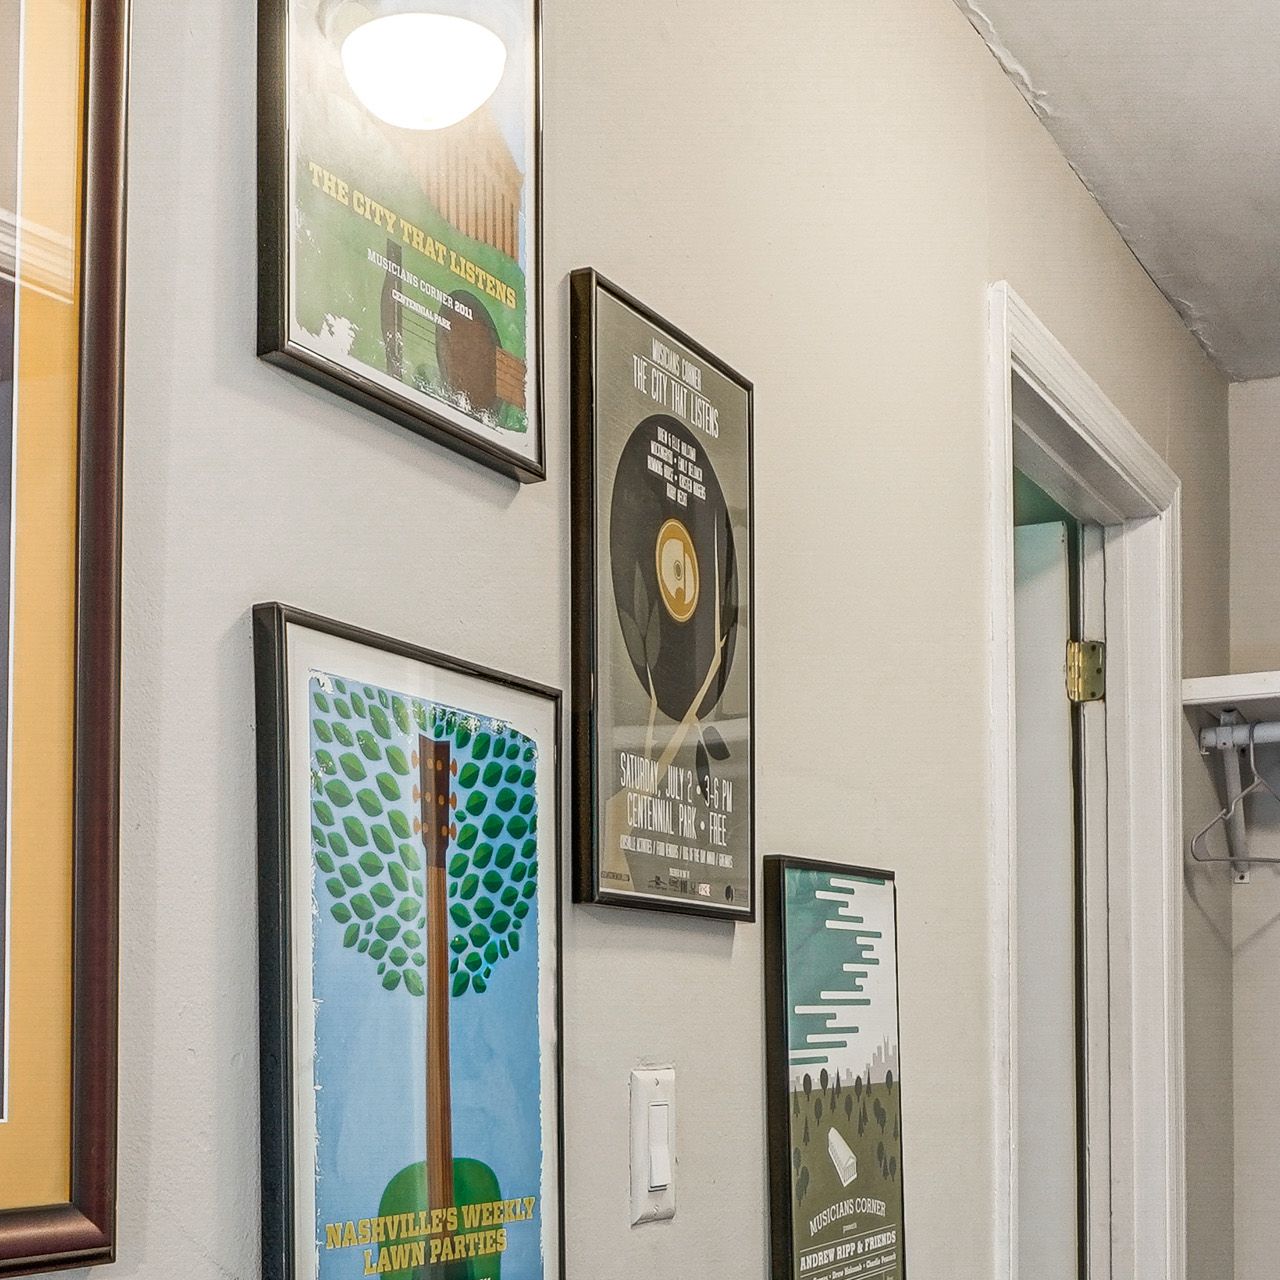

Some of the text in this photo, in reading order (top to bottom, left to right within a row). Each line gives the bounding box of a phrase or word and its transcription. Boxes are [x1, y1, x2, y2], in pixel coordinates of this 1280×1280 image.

[309, 161, 517, 310] THE CITY THAT LISTENS
[367, 247, 473, 321] MUSICIANS CORNER 2011
[391, 289, 452, 331] CENTENNIAL PARK
[632, 354, 719, 438] THE CITY THAT LISTENS
[620, 752, 733, 813] SATURDAY, JULY 2 3-6 PM
[627, 792, 727, 847] CENTENNIAL PARK FREE
[461, 1196, 536, 1230] WEEKLY
[809, 1198, 886, 1237] MUSICIANS CORNER
[363, 1228, 508, 1276] LAWN PARTIES
[800, 1230, 896, 1271] ANDREW RIPP & FRIENDS
